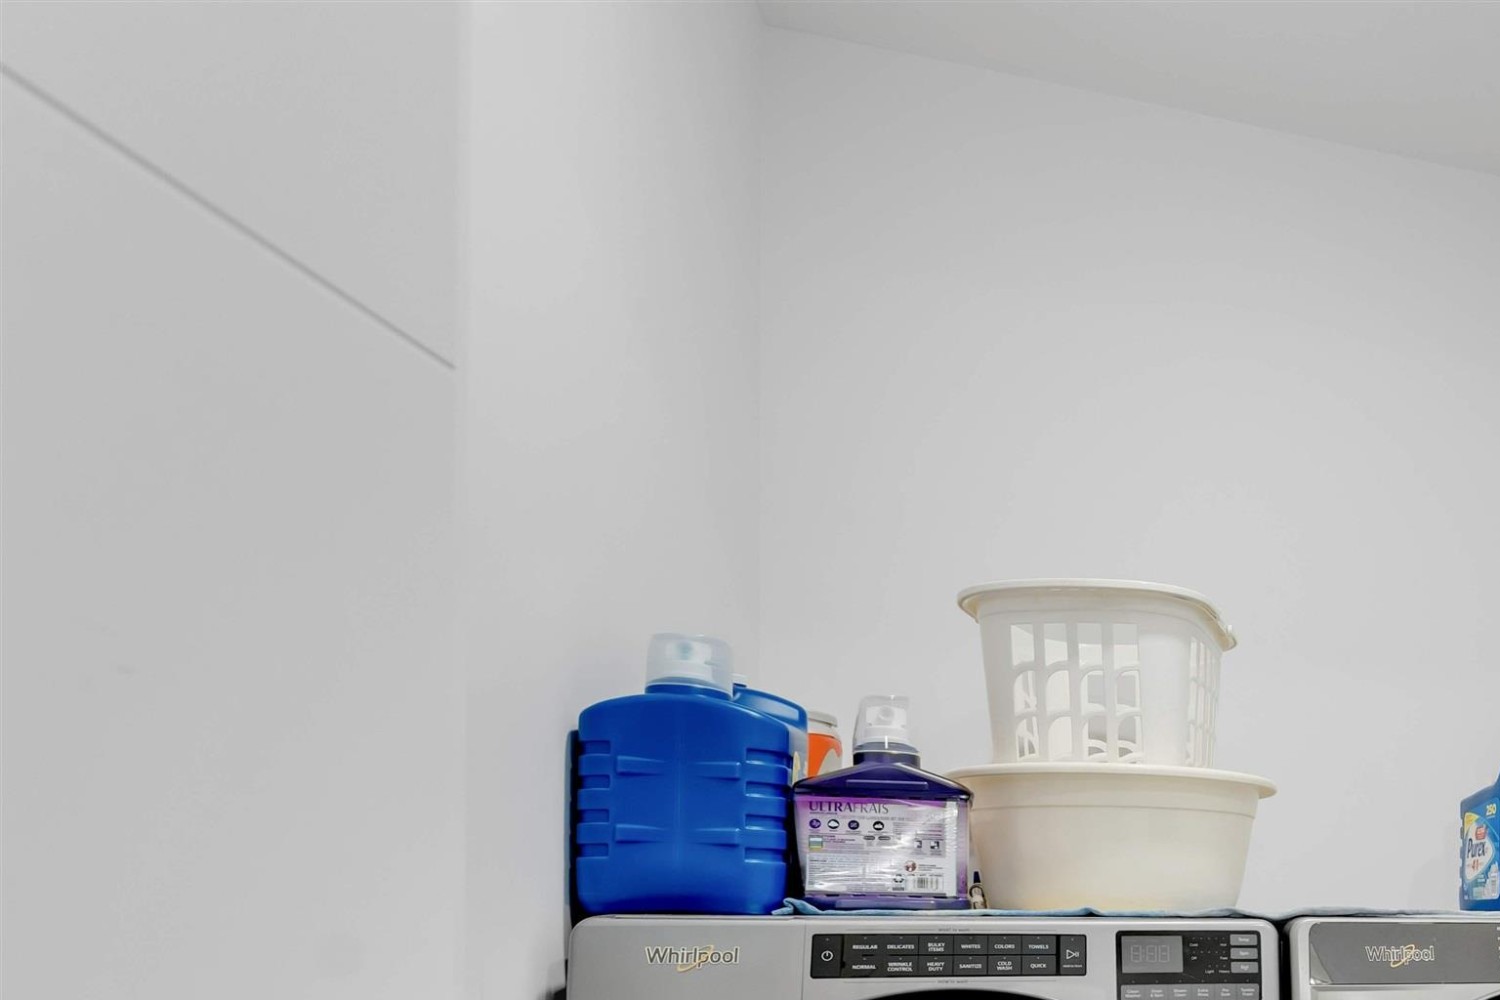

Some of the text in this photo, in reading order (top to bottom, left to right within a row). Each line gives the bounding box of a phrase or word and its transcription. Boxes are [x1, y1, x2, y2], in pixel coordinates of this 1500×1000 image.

[809, 800, 889, 814] ULTRAFRAIS
[1467, 838, 1486, 859] Purex
[645, 946, 740, 970] Whirlpool
[1365, 945, 1435, 966] Whirlpool
